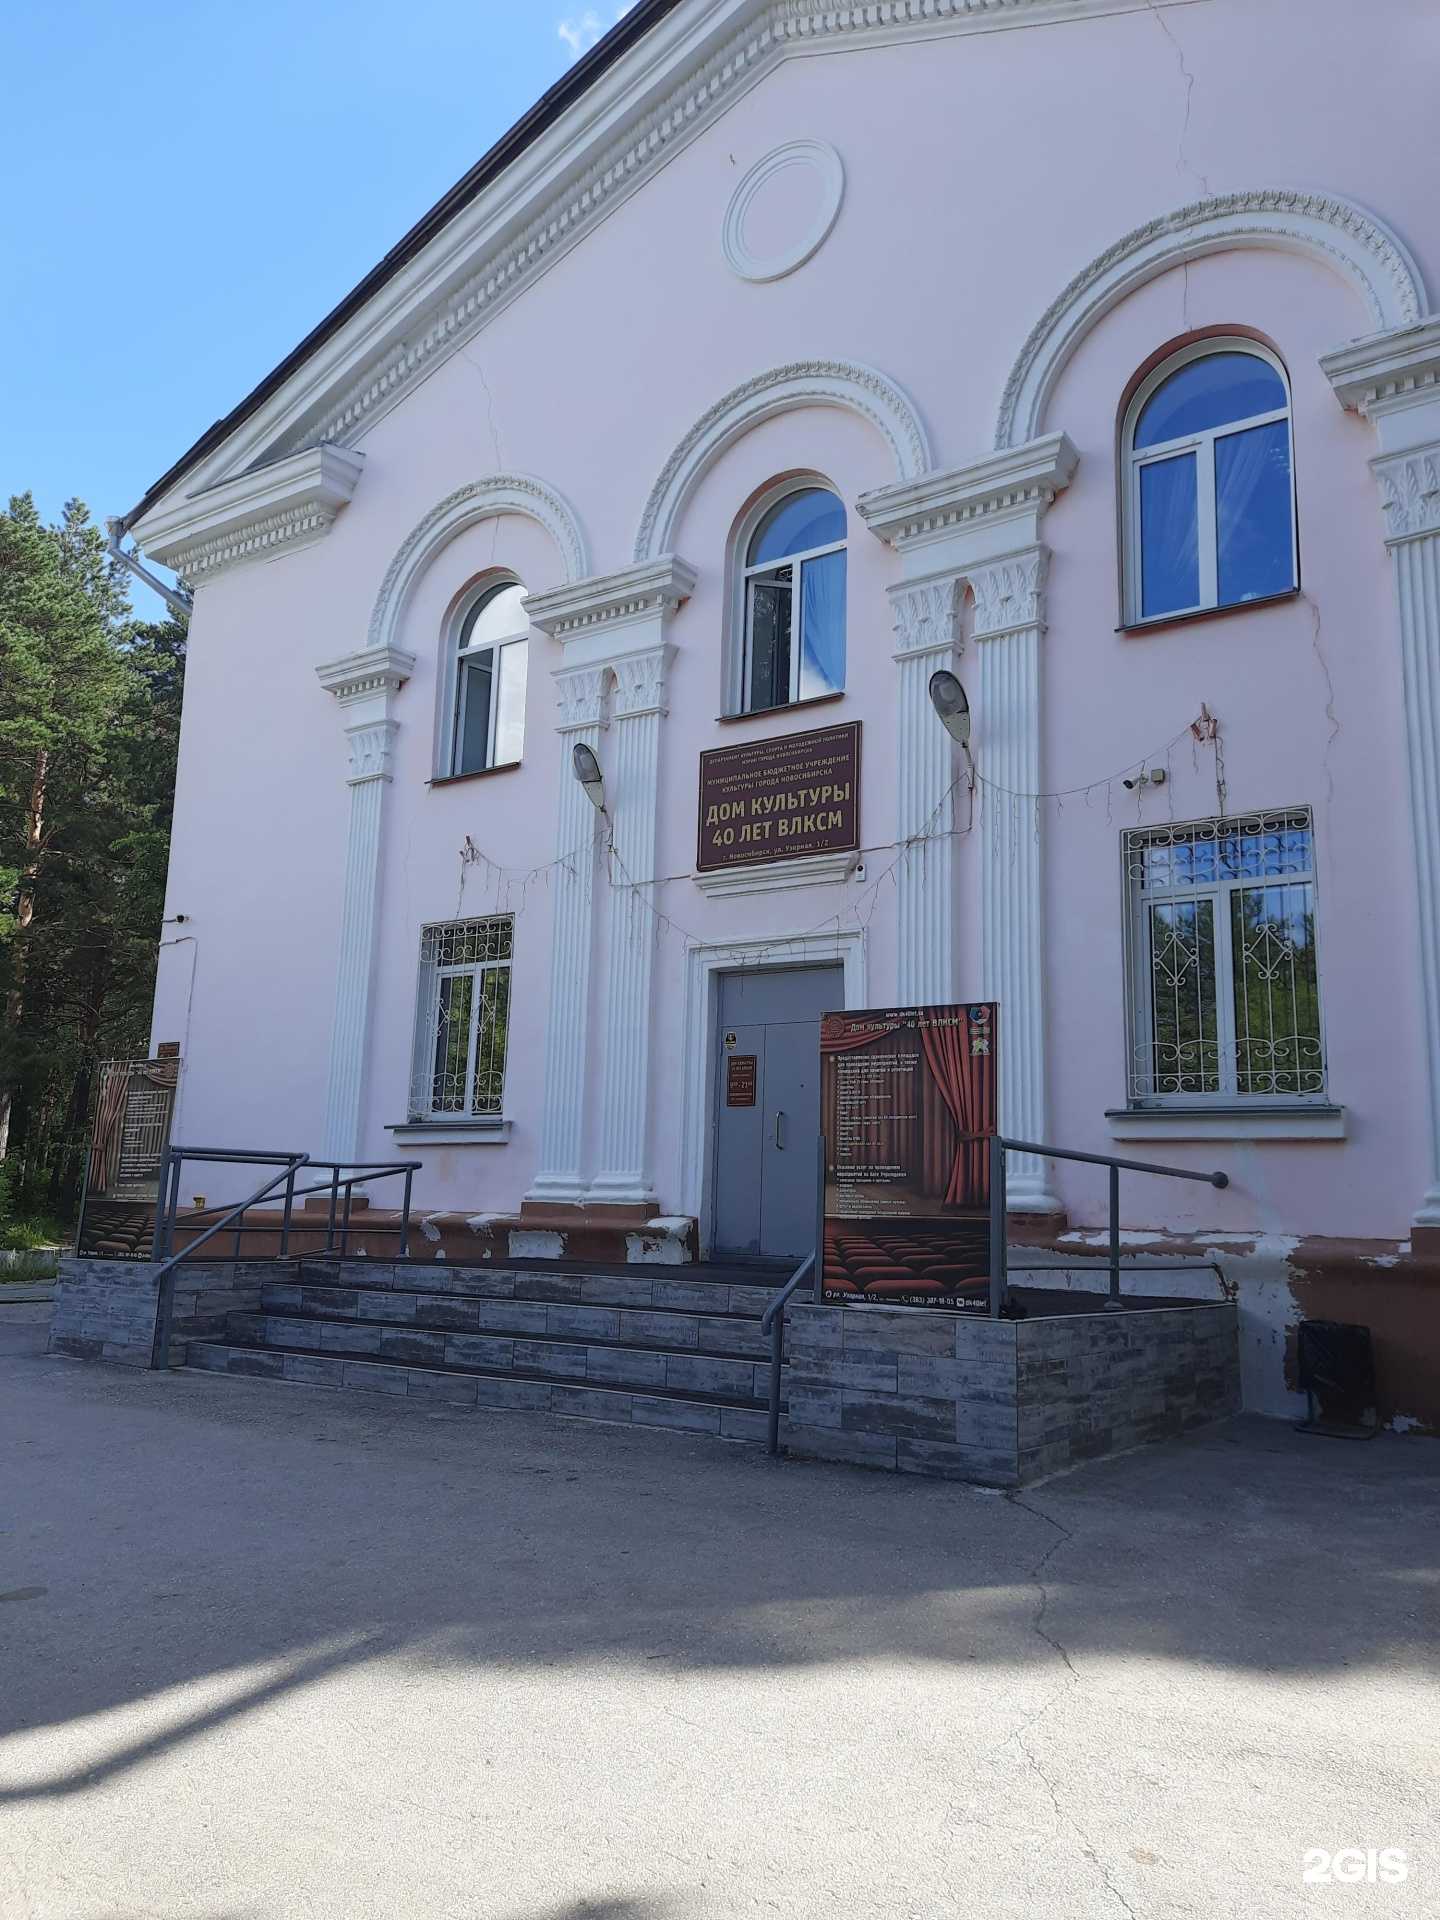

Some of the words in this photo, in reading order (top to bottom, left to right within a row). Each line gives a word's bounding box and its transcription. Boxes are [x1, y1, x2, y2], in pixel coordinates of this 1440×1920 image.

[707, 771, 762, 785] МУНИЦИПАЛЬНОЕ
[763, 763, 804, 777] БЮДЖЕТНОЕ
[805, 754, 850, 769] УЧРЕЖДЕНИЕ
[721, 782, 754, 793] КУЛЬТУРЫ
[755, 777, 780, 789] ГОРОДА
[781, 768, 833, 783] НОВОСИБИРСКА
[705, 800, 745, 827] ДОМ
[751, 782, 850, 817] КУЛЬТУРЫ
[712, 827, 735, 847] 40
[738, 821, 773, 842] ЛЕТ
[778, 810, 843, 837] ВЛКСМ
[850, 1023, 864, 1033] Дом
[866, 1021, 901, 1033] культуры
[917, 1020, 930, 1029] лет
